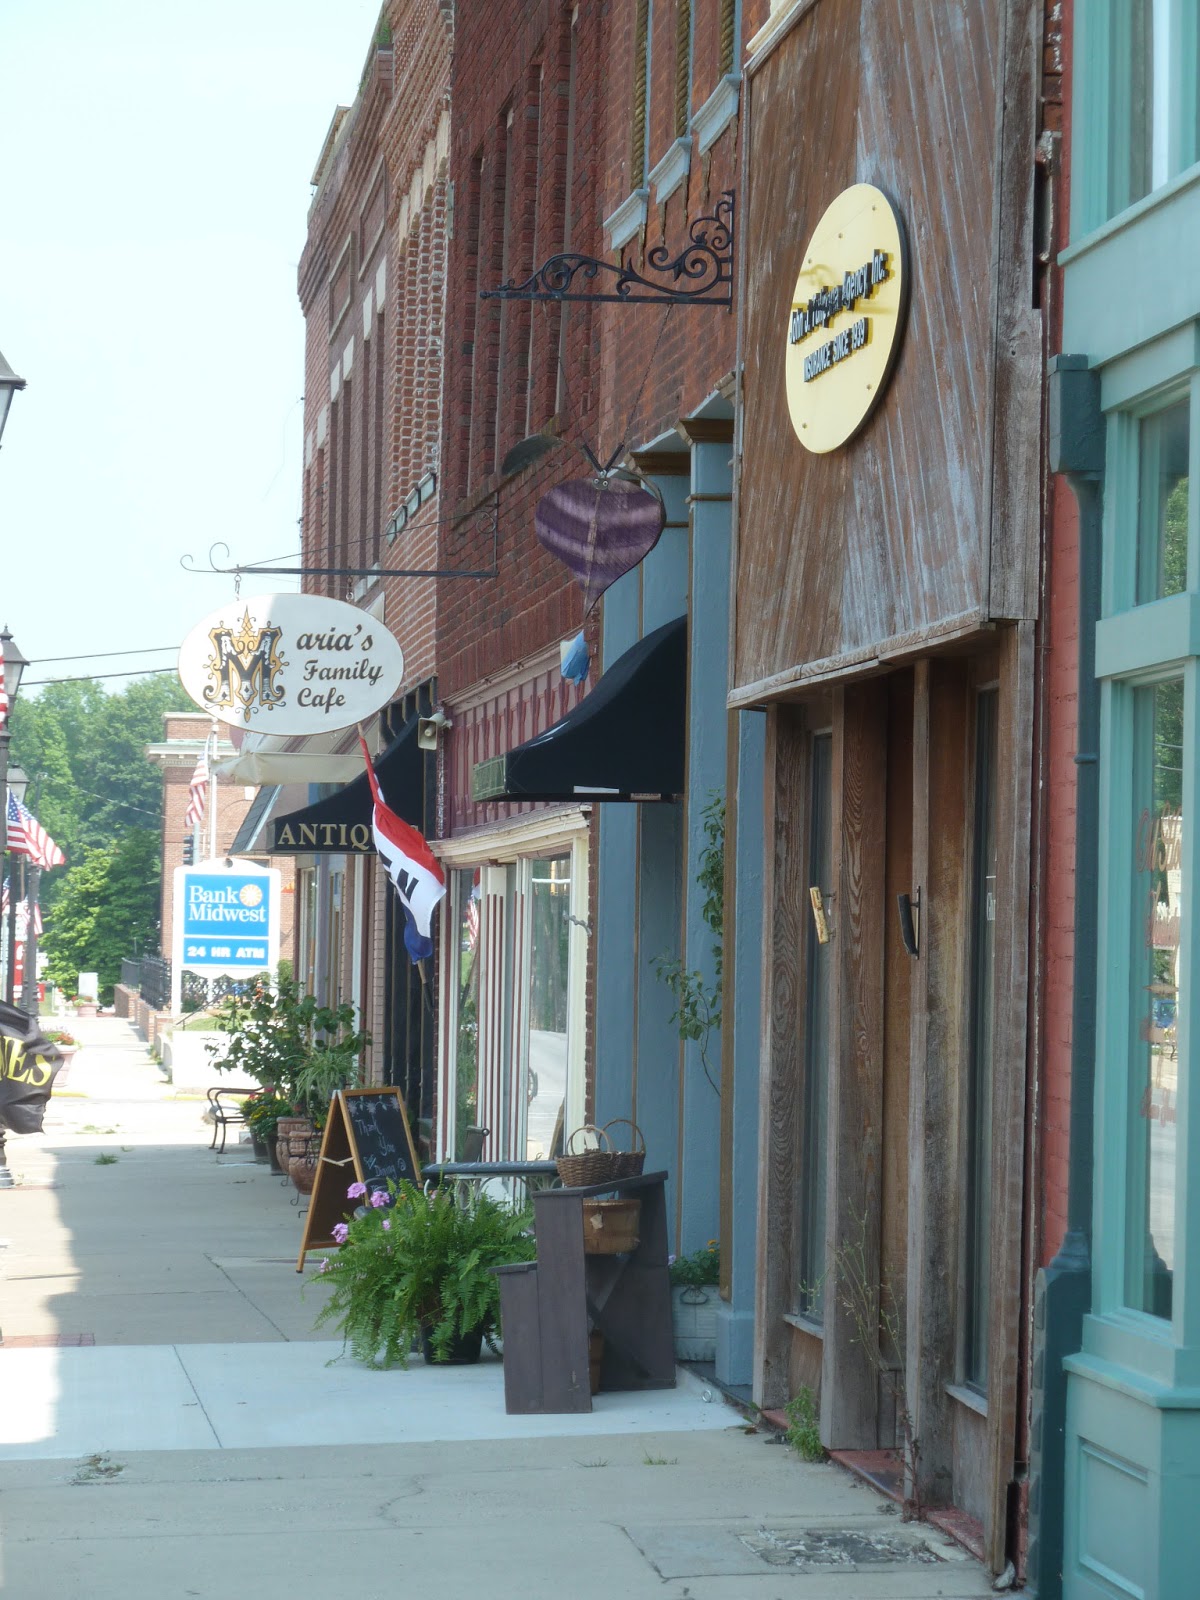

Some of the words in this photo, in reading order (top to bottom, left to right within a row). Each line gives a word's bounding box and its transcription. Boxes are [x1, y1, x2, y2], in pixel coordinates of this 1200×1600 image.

[833, 328, 850, 362] SINCE
[303, 658, 384, 686] Family
[297, 688, 346, 714] Cafe
[277, 823, 419, 851] ANTIQ
[189, 885, 239, 904] Bank
[188, 903, 266, 923] Midwest
[187, 946, 206, 957] 24
[211, 947, 231, 958] HR
[235, 947, 265, 959] ATM
